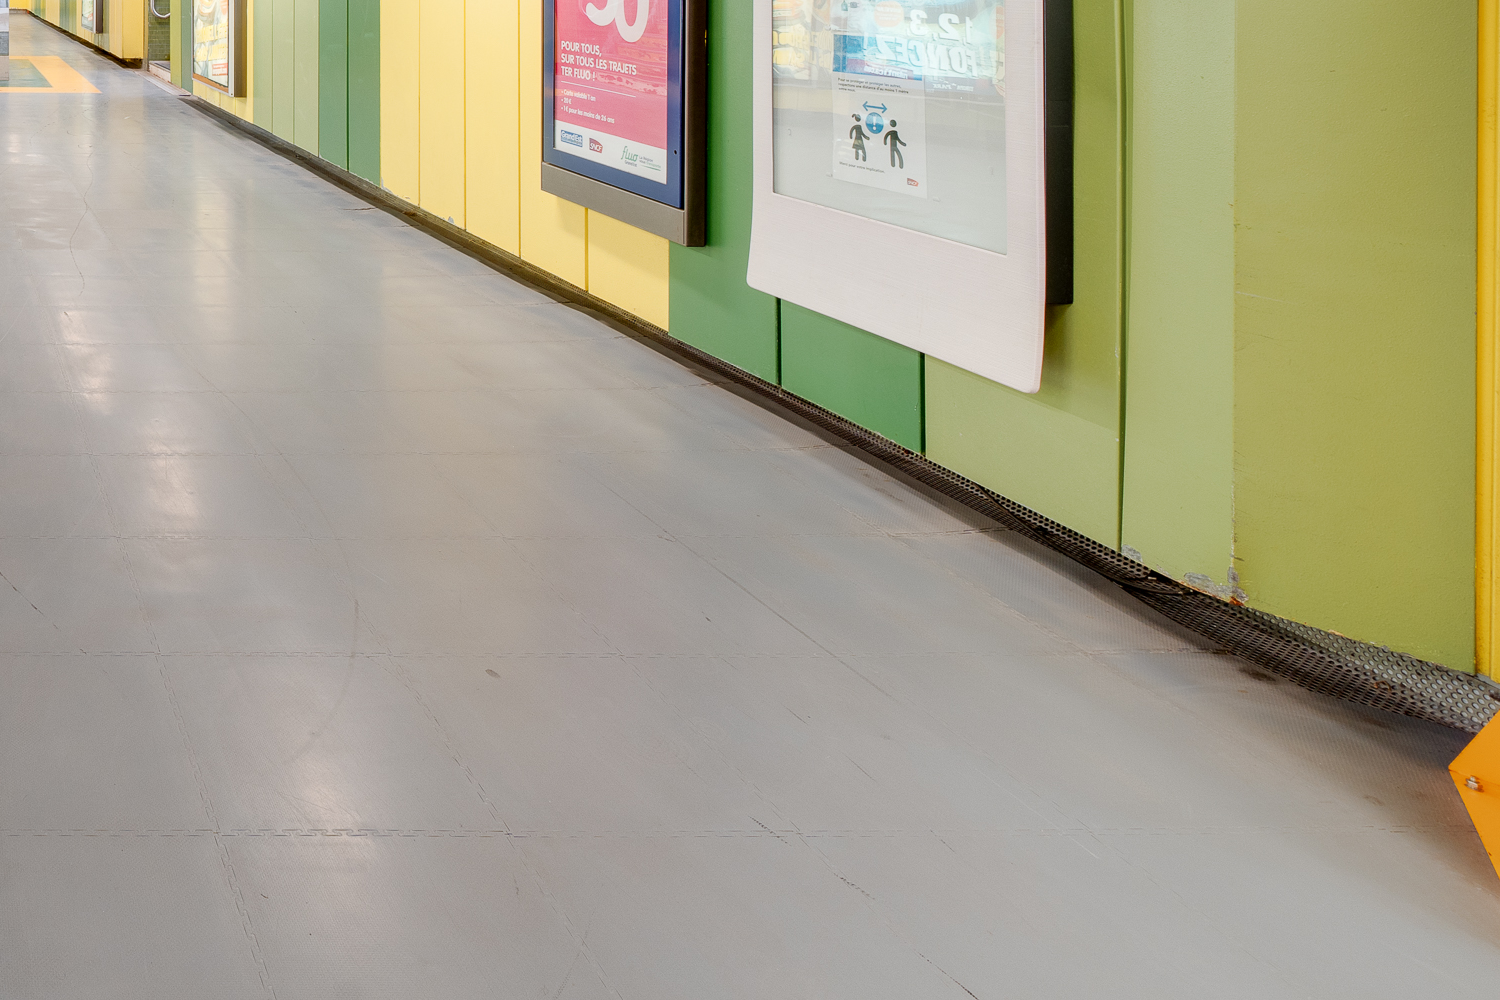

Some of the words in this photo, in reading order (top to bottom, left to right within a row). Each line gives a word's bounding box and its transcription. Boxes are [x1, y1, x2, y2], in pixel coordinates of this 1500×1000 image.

[561, 41, 580, 52] POUR
[581, 43, 602, 57] TOUS,
[561, 53, 574, 64] SUR
[576, 56, 594, 68] TOUS
[596, 59, 607, 70] LES
[609, 61, 637, 75] TRAJETS
[561, 66, 572, 77] TER
[574, 68, 591, 80] FLUO
[564, 89, 574, 97] Carte
[574, 91, 587, 100] valable
[590, 143, 602, 151] SNCF
[621, 146, 638, 162] fluo
